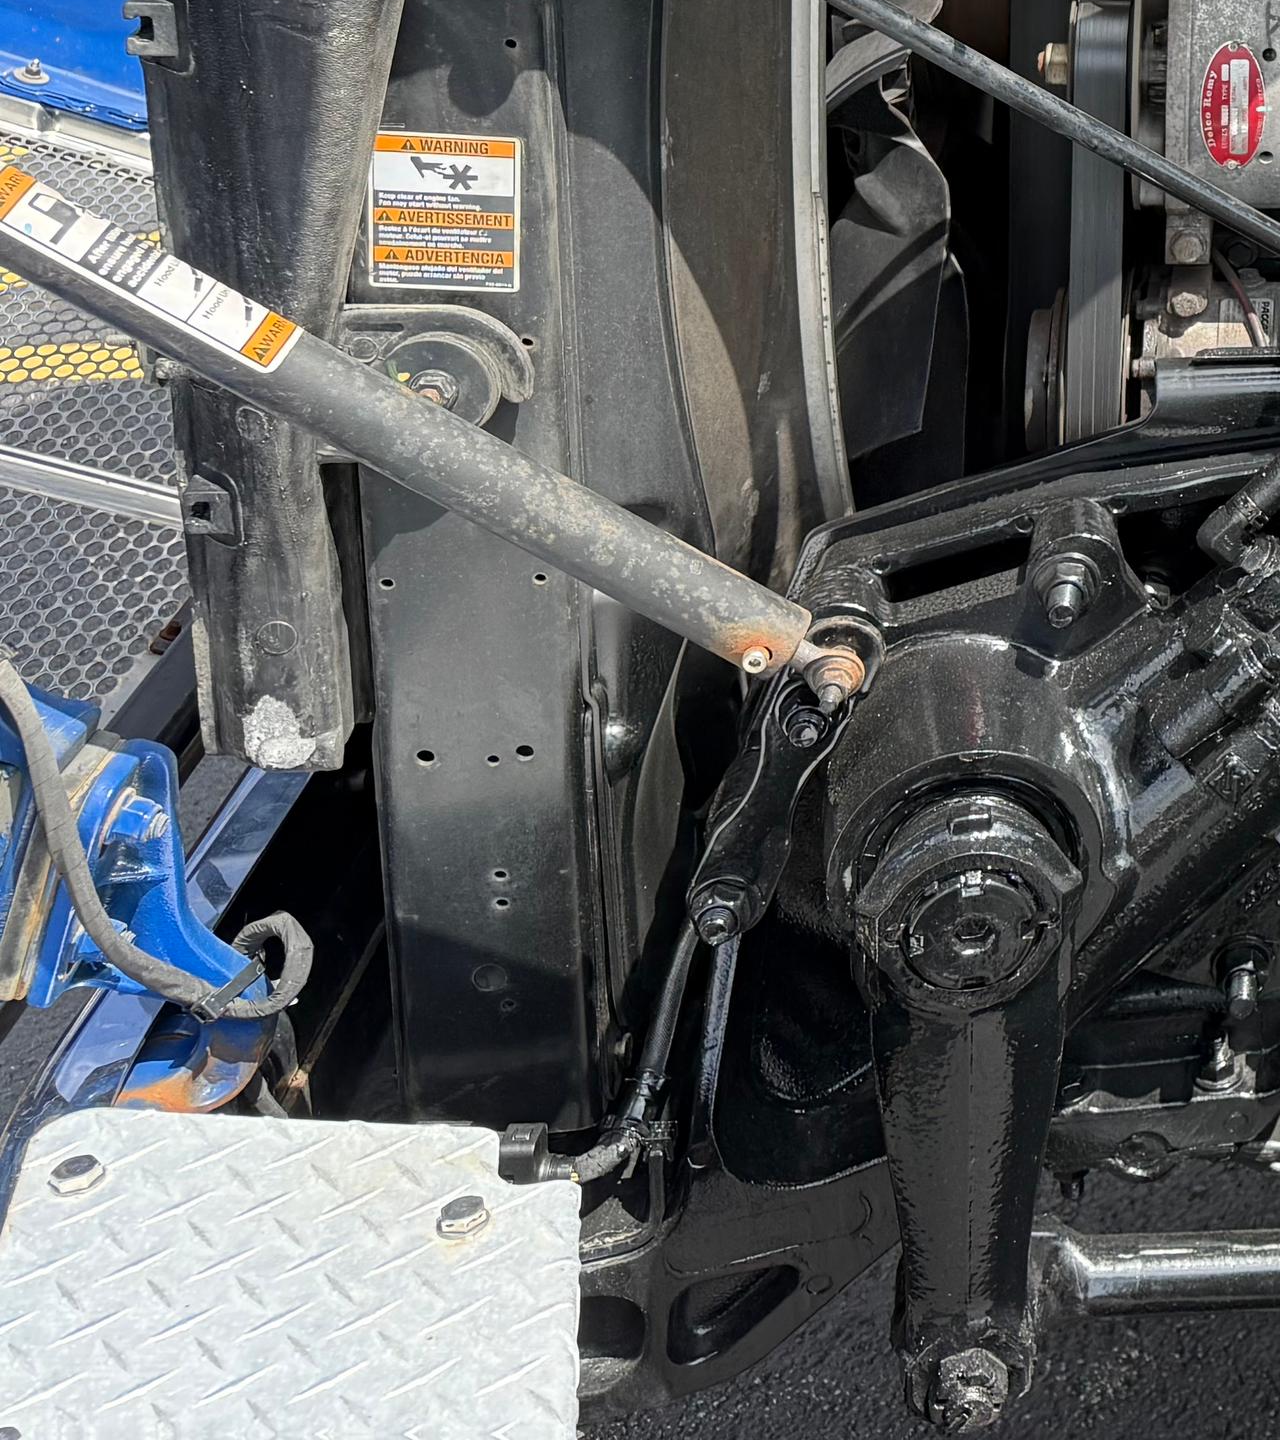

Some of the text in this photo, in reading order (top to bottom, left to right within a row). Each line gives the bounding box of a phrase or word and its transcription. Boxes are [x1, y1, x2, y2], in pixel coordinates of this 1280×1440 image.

[1203, 70, 1217, 148] Delco Remy
[420, 139, 489, 154] WARNING
[398, 211, 511, 227] AVERTISSEMENT
[88, 234, 110, 264] After
[405, 249, 504, 264] ADVERTENCIA
[154, 264, 174, 288] Hood
[203, 295, 223, 320] Hood
